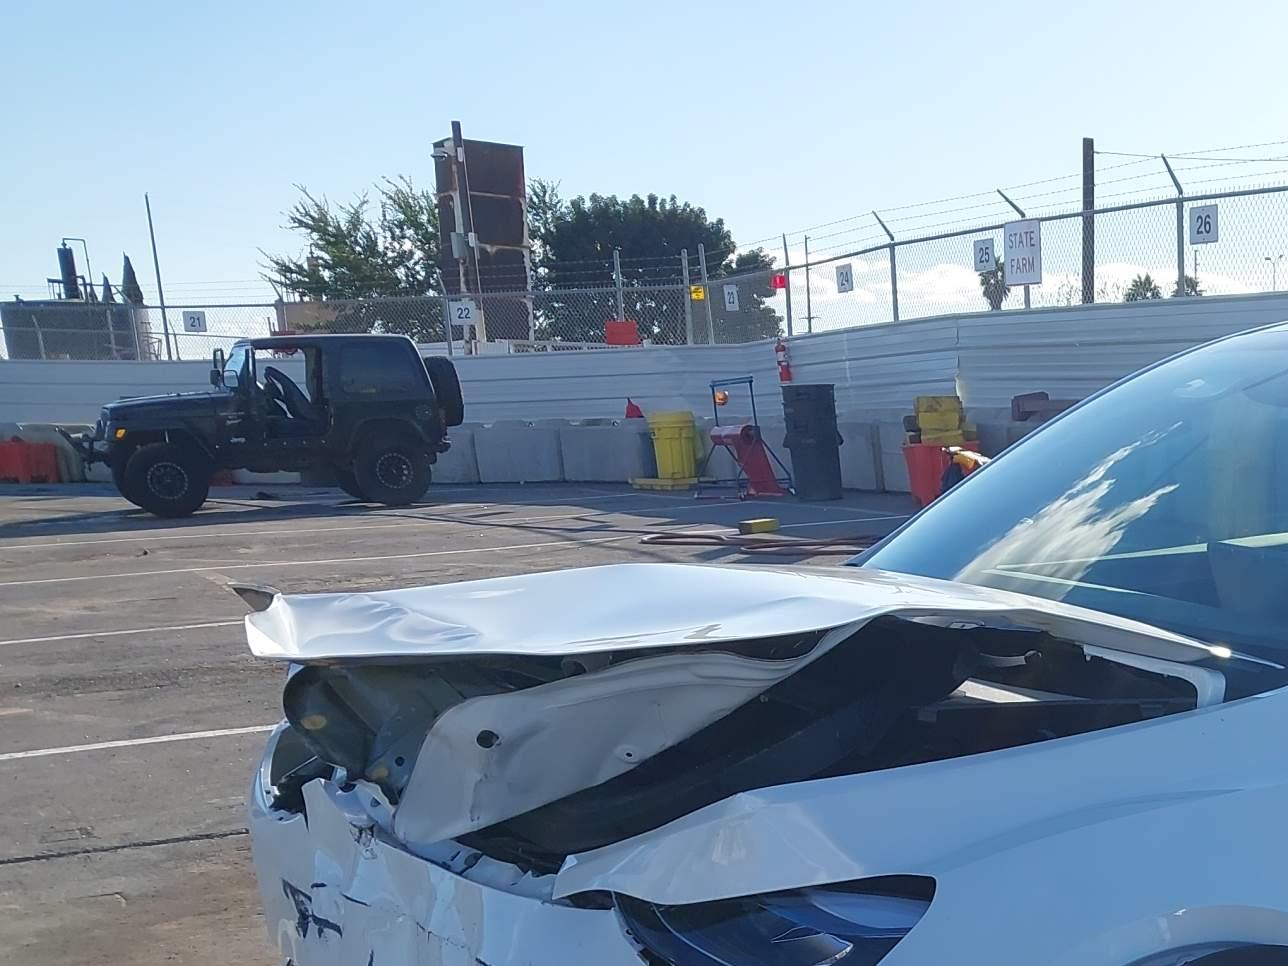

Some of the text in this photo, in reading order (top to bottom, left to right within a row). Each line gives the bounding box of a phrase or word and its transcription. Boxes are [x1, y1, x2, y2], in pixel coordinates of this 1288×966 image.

[1196, 214, 1212, 235] 26
[1008, 230, 1036, 249] STATE
[978, 247, 990, 264] 25
[1010, 256, 1035, 274] FARM
[840, 271, 849, 287] 24
[189, 316, 201, 328] 21
[456, 307, 471, 320] 22
